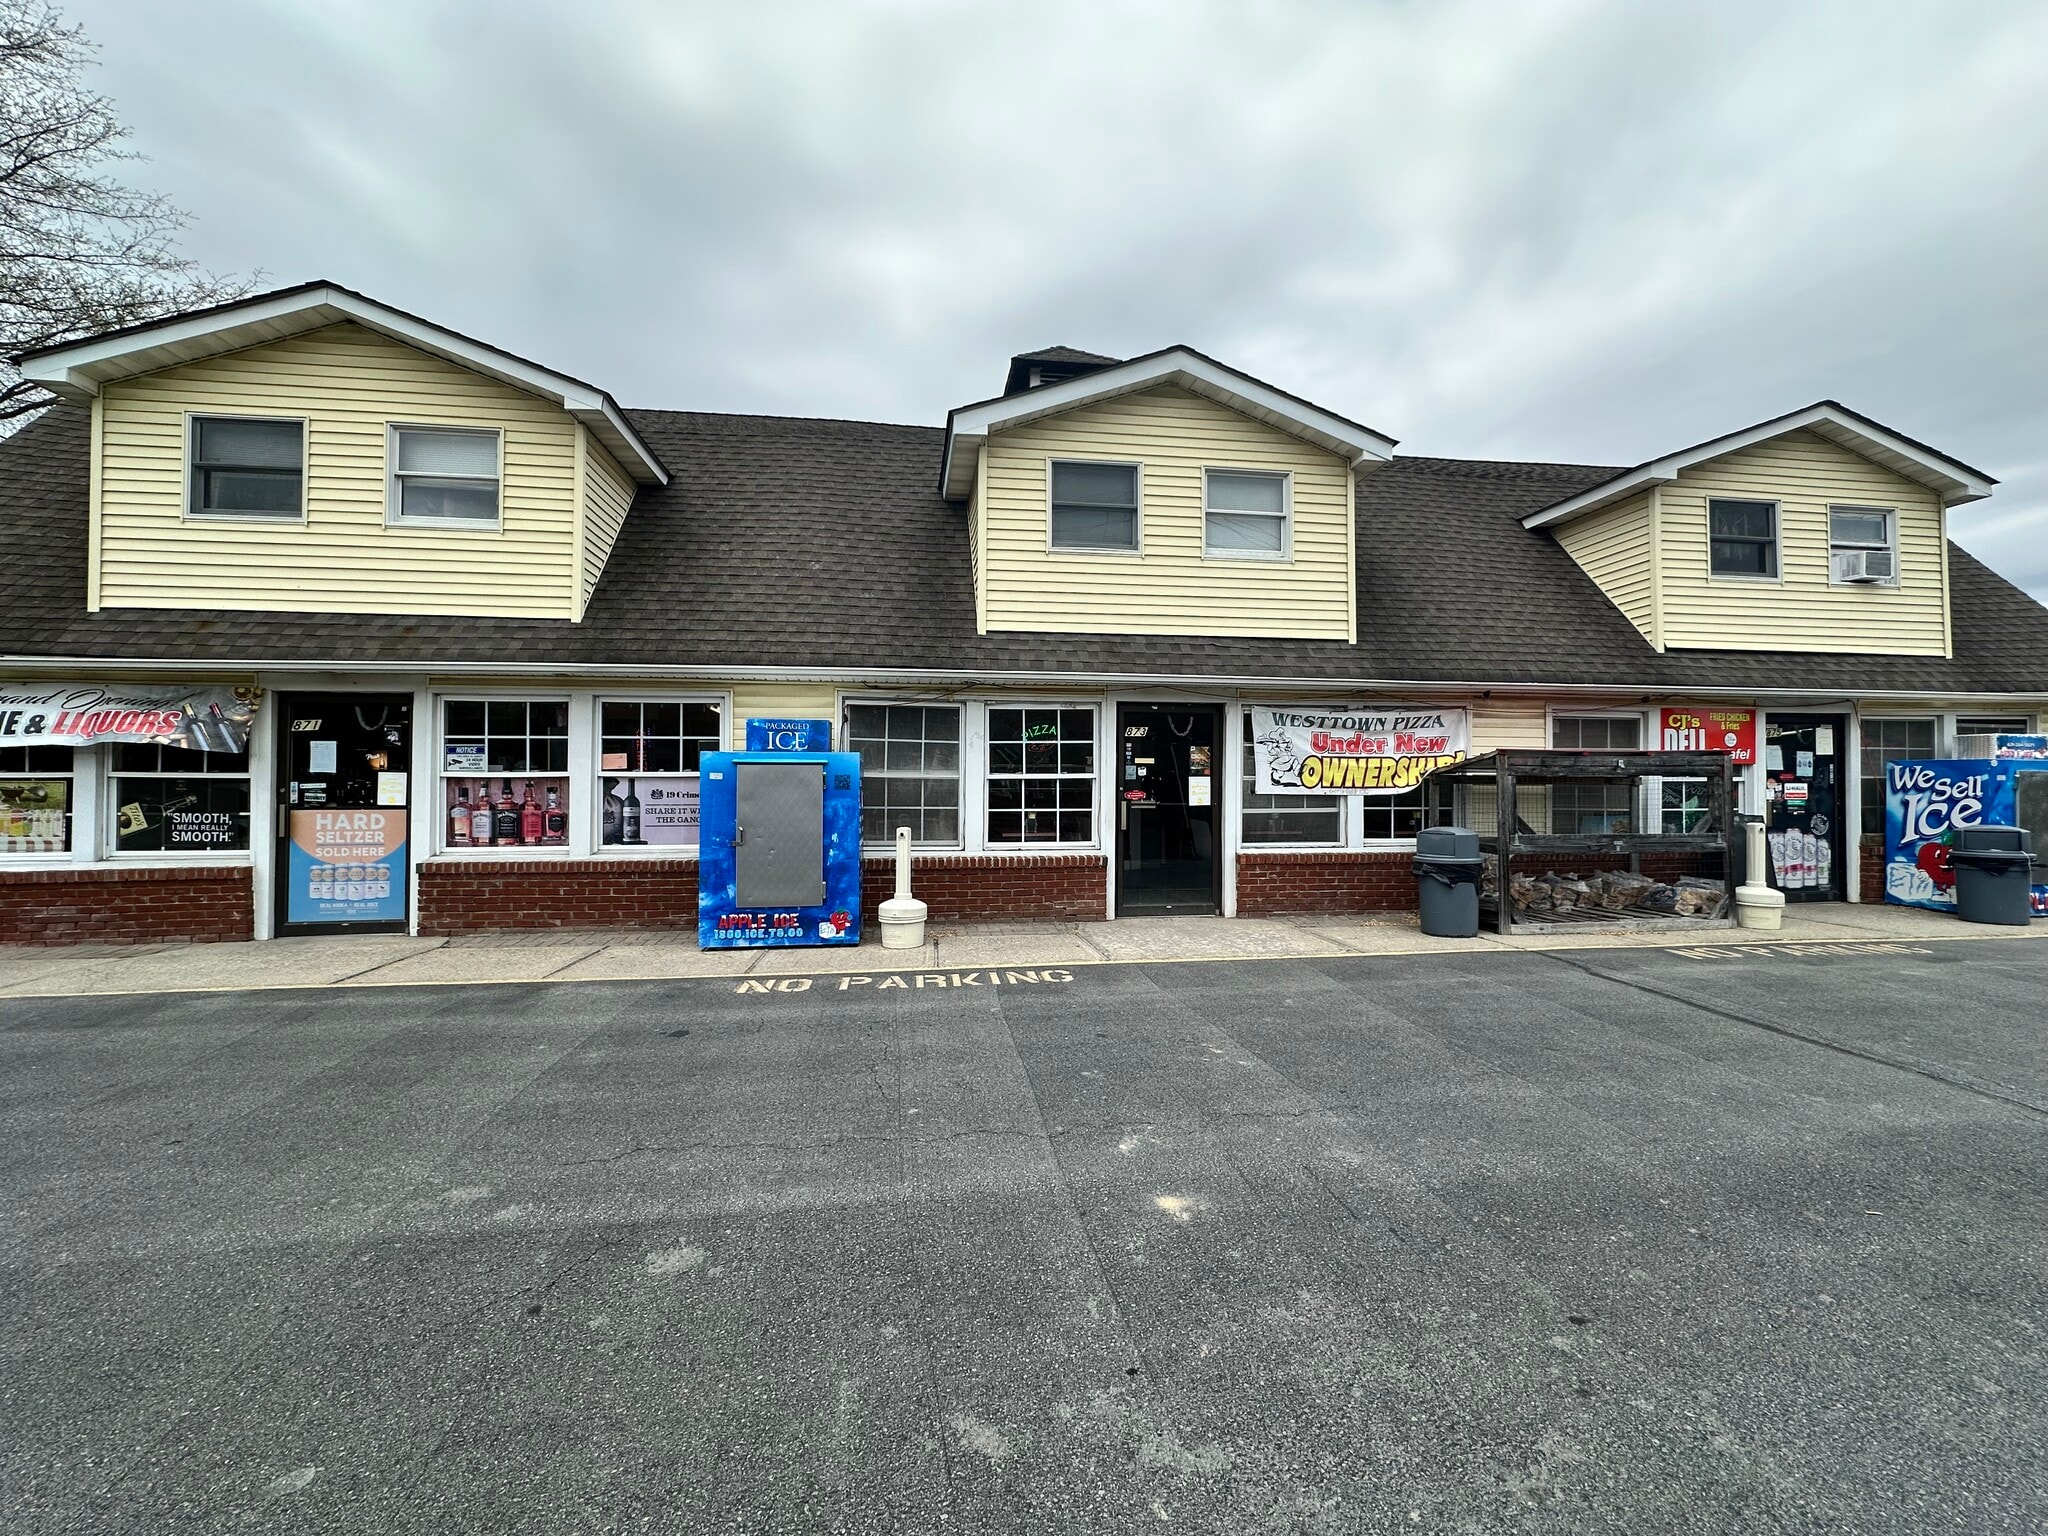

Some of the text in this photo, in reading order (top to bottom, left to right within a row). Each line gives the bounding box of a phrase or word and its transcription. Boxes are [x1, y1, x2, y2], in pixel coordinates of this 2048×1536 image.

[0, 687, 67, 705] rand
[24, 714, 46, 735] &
[51, 709, 183, 739] LIQUORS
[293, 720, 320, 730] 871
[1271, 712, 1445, 731] WESTTOWN PIZZA
[1668, 714, 1701, 730] CJ's
[1726, 713, 1750, 721] CHICKEN
[764, 722, 810, 730] PACKAGED
[1021, 724, 1057, 742] PIZZA
[1126, 727, 1147, 736] 873
[766, 731, 809, 750] ICE
[1310, 731, 1450, 754] Under New
[1892, 764, 1984, 801] We Sell
[645, 807, 677, 815] SHARE
[1900, 793, 1983, 845] Ice
[315, 813, 386, 830] HARD
[656, 816, 676, 824] THE
[315, 831, 385, 843] SELTZER
[315, 847, 385, 857] SOLD HERE
[718, 912, 800, 928] APPLE ICE
[735, 968, 1075, 995] NO PARKING
